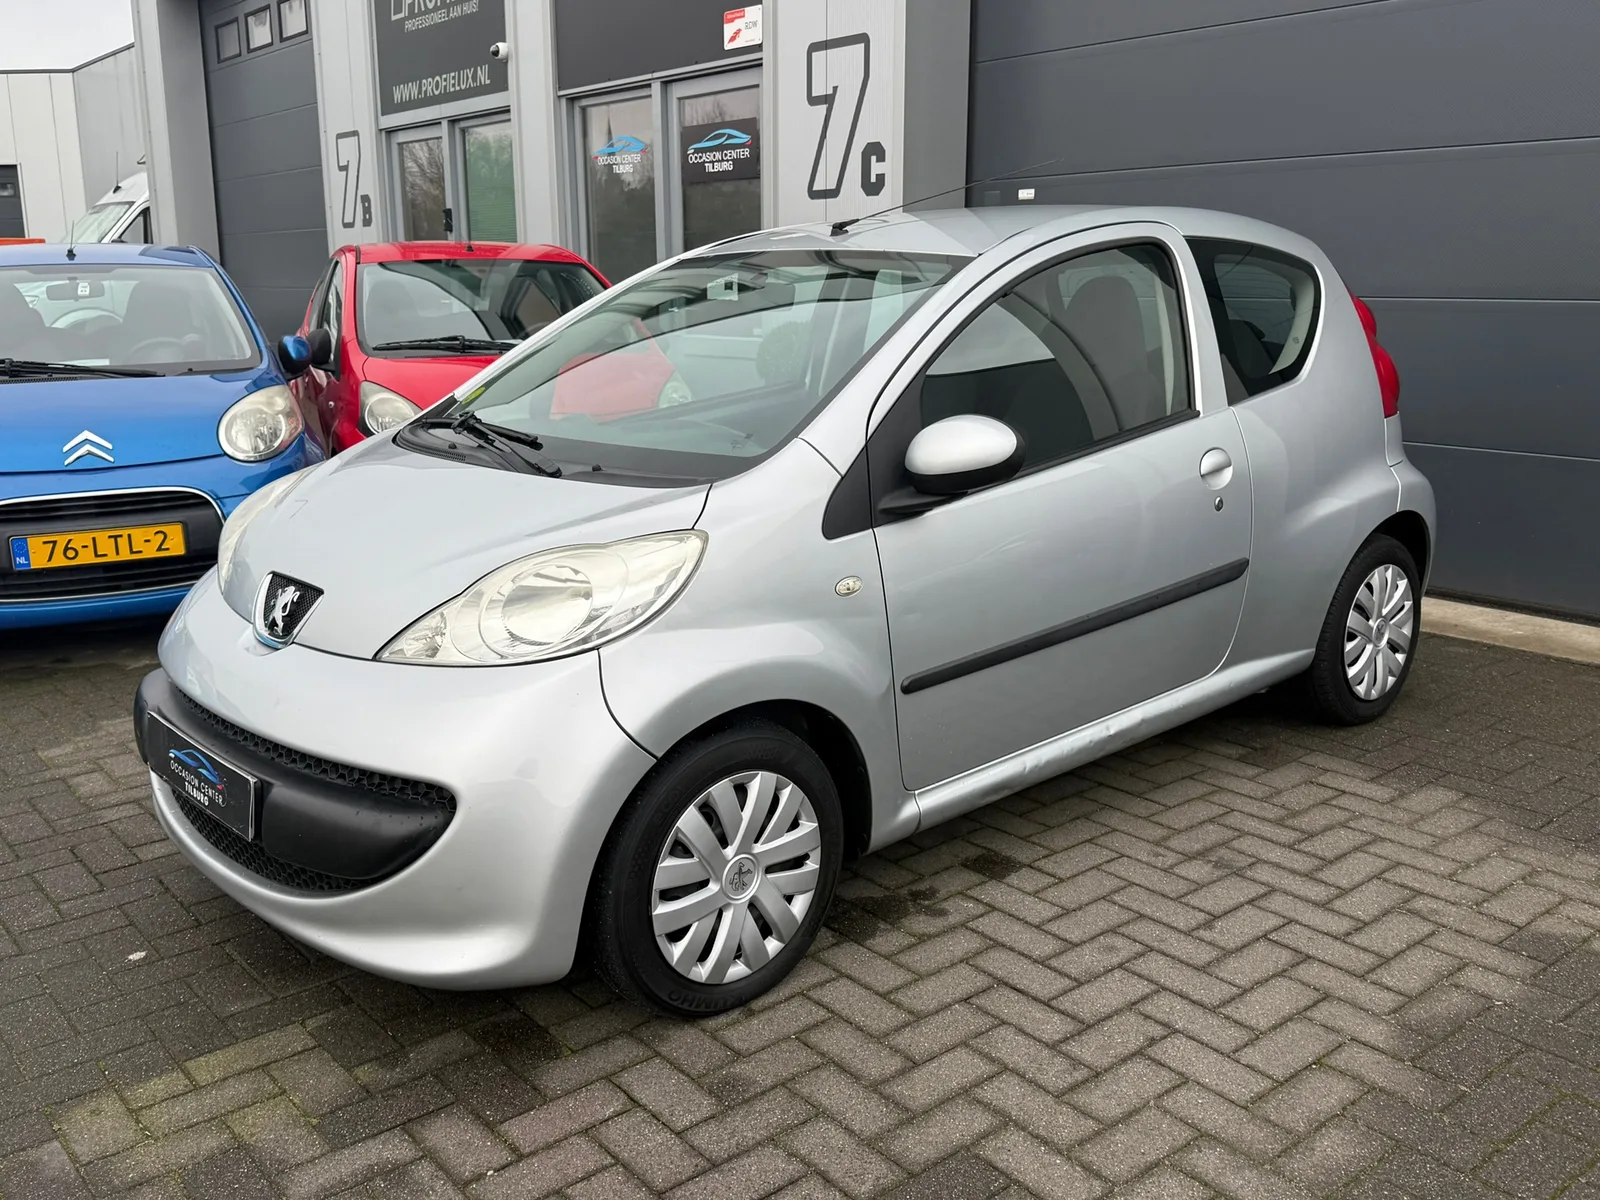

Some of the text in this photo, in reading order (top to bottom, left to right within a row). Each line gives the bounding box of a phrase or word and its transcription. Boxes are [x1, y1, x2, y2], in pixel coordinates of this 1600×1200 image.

[404, 9, 448, 33] PROFESSIONEEL
[449, 4, 461, 19] AAN
[393, 64, 491, 104] WWW.PROFIELUX.NL
[806, 32, 871, 200] 7
[597, 153, 642, 165] OCCASION CENTER
[612, 164, 634, 174] TILBURG
[688, 148, 750, 164] OCCASION CENTER
[704, 161, 734, 172] TILBURG
[336, 130, 361, 228] 7
[42, 530, 170, 563] 76-LTL-2
[16, 556, 29, 565] NL
[170, 760, 223, 807] OCCASION CENTER
[184, 781, 209, 806] TILBURG
